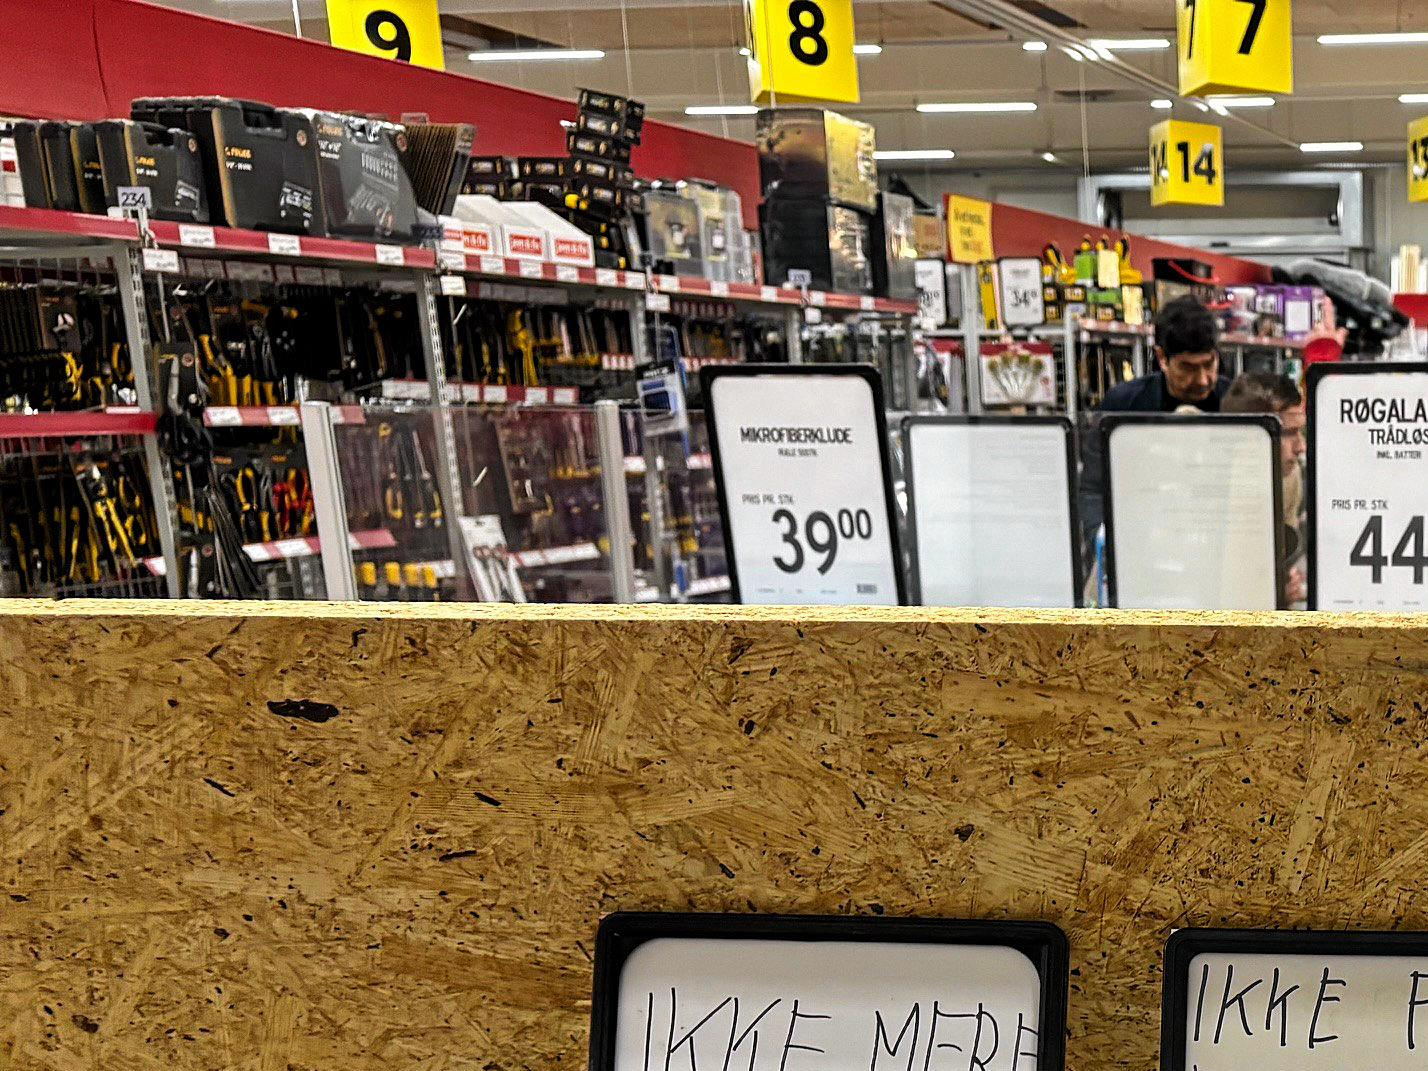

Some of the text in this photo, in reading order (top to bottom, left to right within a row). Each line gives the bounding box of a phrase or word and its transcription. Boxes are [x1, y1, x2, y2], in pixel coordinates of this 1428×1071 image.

[365, 9, 412, 63] 9
[788, 0, 828, 66] 8
[1232, 0, 1268, 55] 7
[1177, 141, 1216, 185] 14
[740, 427, 853, 443] MIKROFIBERKLUDE
[1331, 499, 1351, 510] PRIS
[1193, 963, 1347, 1049] IKKE
